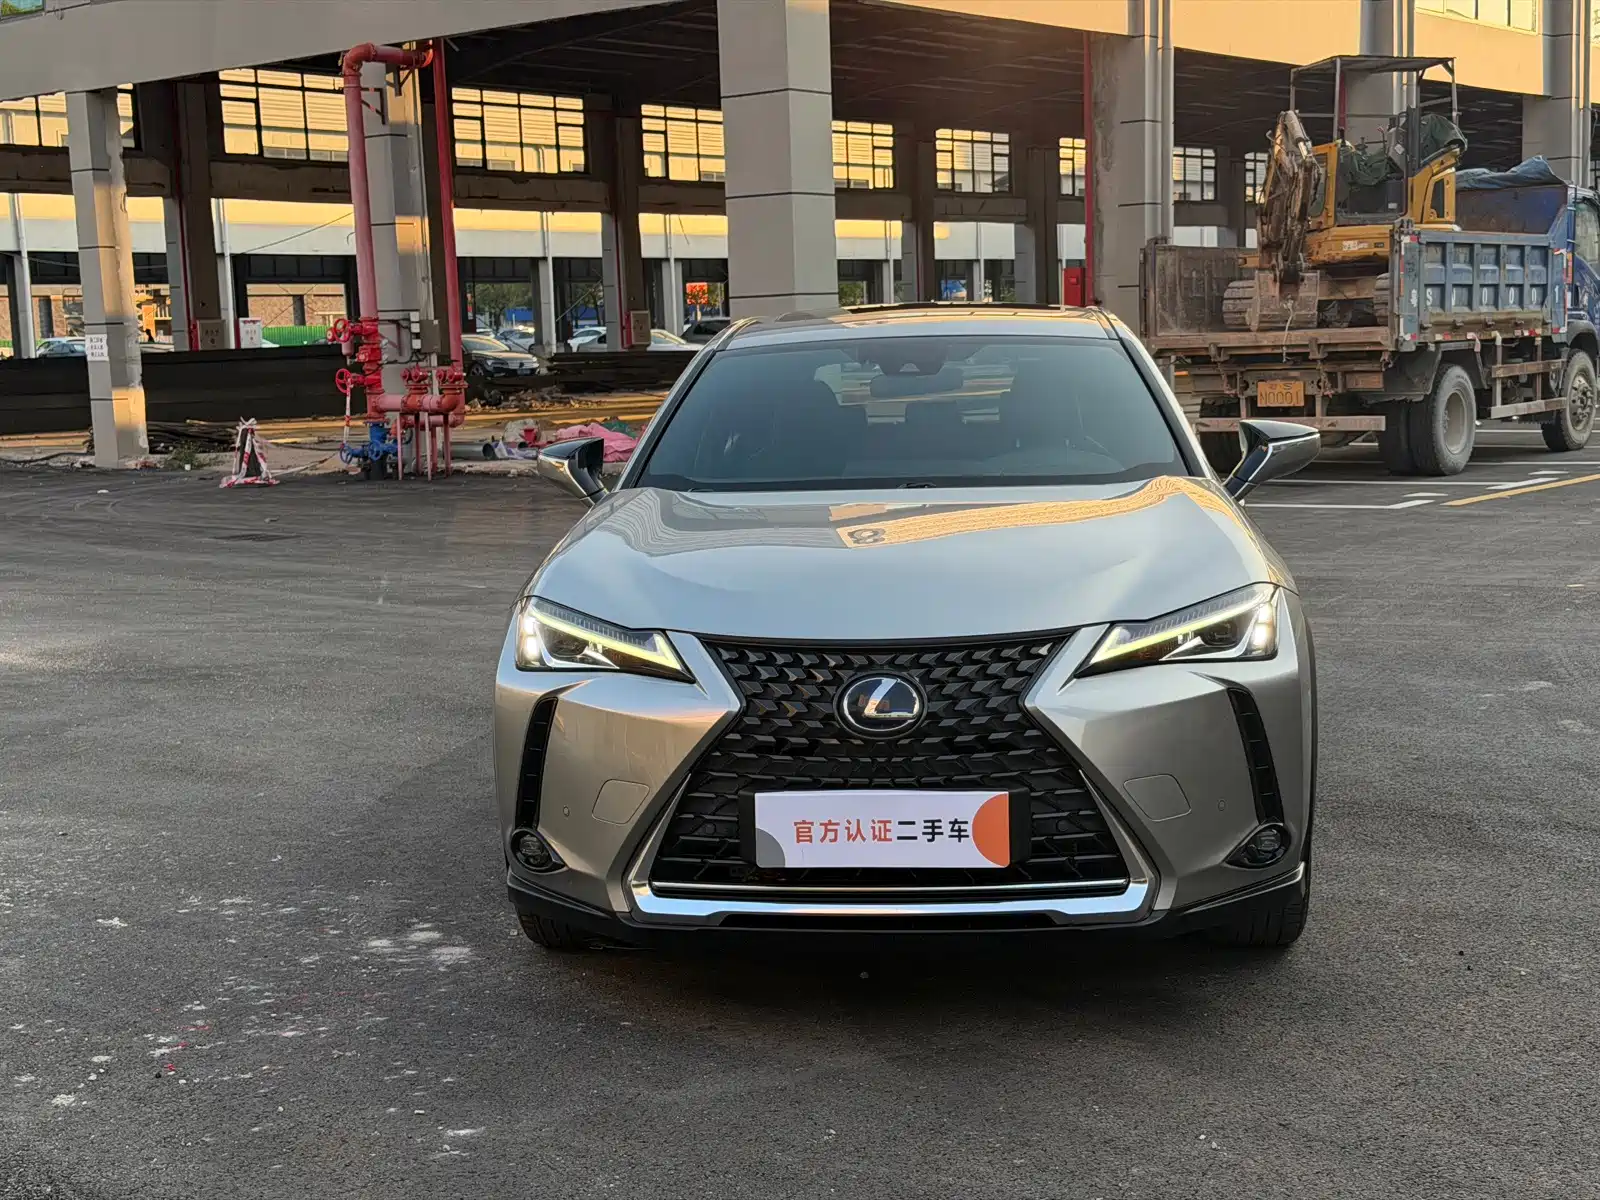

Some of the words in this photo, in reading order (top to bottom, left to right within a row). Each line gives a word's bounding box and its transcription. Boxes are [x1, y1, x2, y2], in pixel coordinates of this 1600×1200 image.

[793, 818, 970, 844] 官方认证二手车
